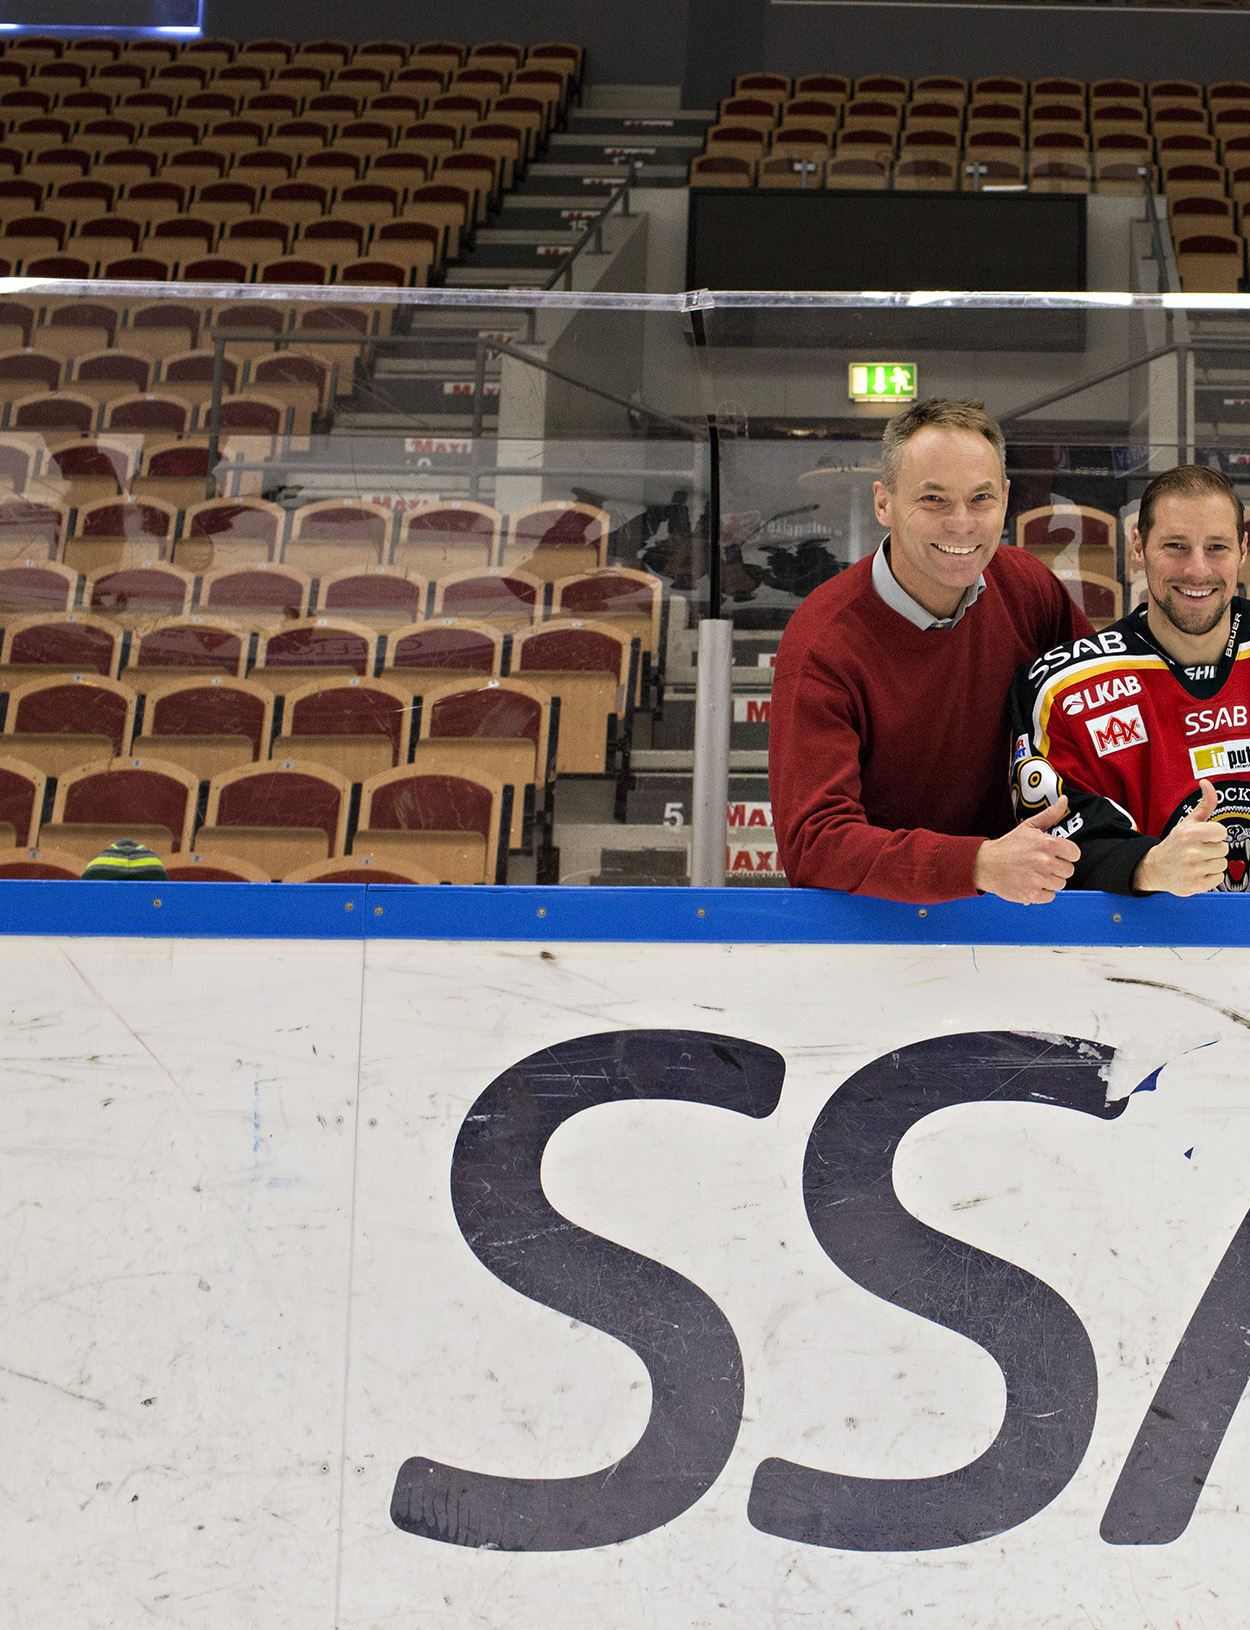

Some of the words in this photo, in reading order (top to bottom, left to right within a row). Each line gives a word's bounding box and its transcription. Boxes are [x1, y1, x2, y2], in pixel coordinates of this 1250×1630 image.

[1224, 612, 1242, 658] BAUER
[1028, 631, 1127, 689] SSAB
[1083, 675, 1142, 710] LKAB
[1185, 705, 1248, 736] SSAB
[662, 802, 685, 827] 5
